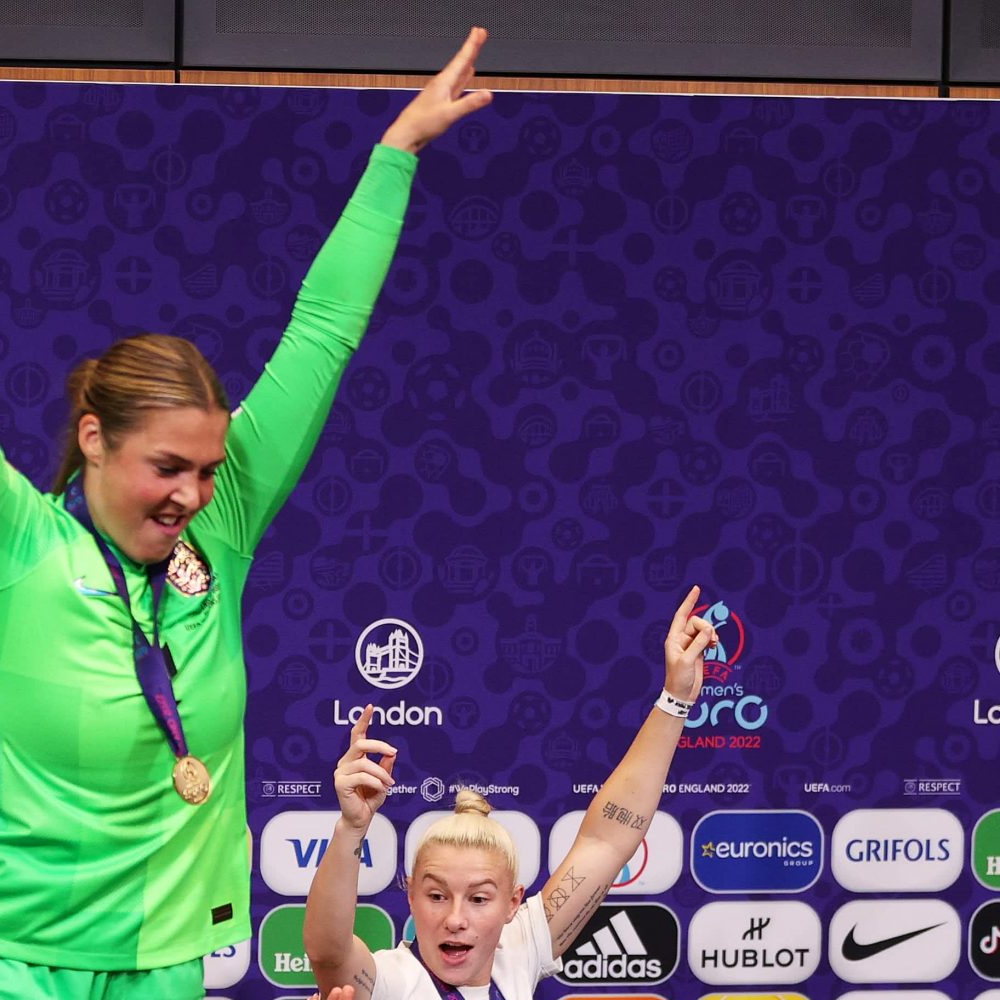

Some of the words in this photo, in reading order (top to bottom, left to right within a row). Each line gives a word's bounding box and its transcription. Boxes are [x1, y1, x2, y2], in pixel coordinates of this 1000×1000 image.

[703, 665, 729, 680] EFA
[701, 683, 743, 697] men's
[334, 700, 442, 726] London
[679, 736, 726, 749] GLAND
[728, 736, 761, 748] 2022
[277, 784, 321, 794] RESPECT
[386, 784, 417, 796] gether
[573, 784, 599, 793] UEFA
[678, 784, 725, 793] ENGLAND
[727, 784, 749, 793] 2022
[804, 783, 851, 793] UEFA.com
[918, 782, 961, 792] RESPECT
[285, 839, 373, 868] VIA
[715, 836, 813, 859] euronics
[845, 838, 950, 862] GRIFOLS
[701, 949, 809, 968] HUBLOT
[564, 954, 661, 979] adidas
